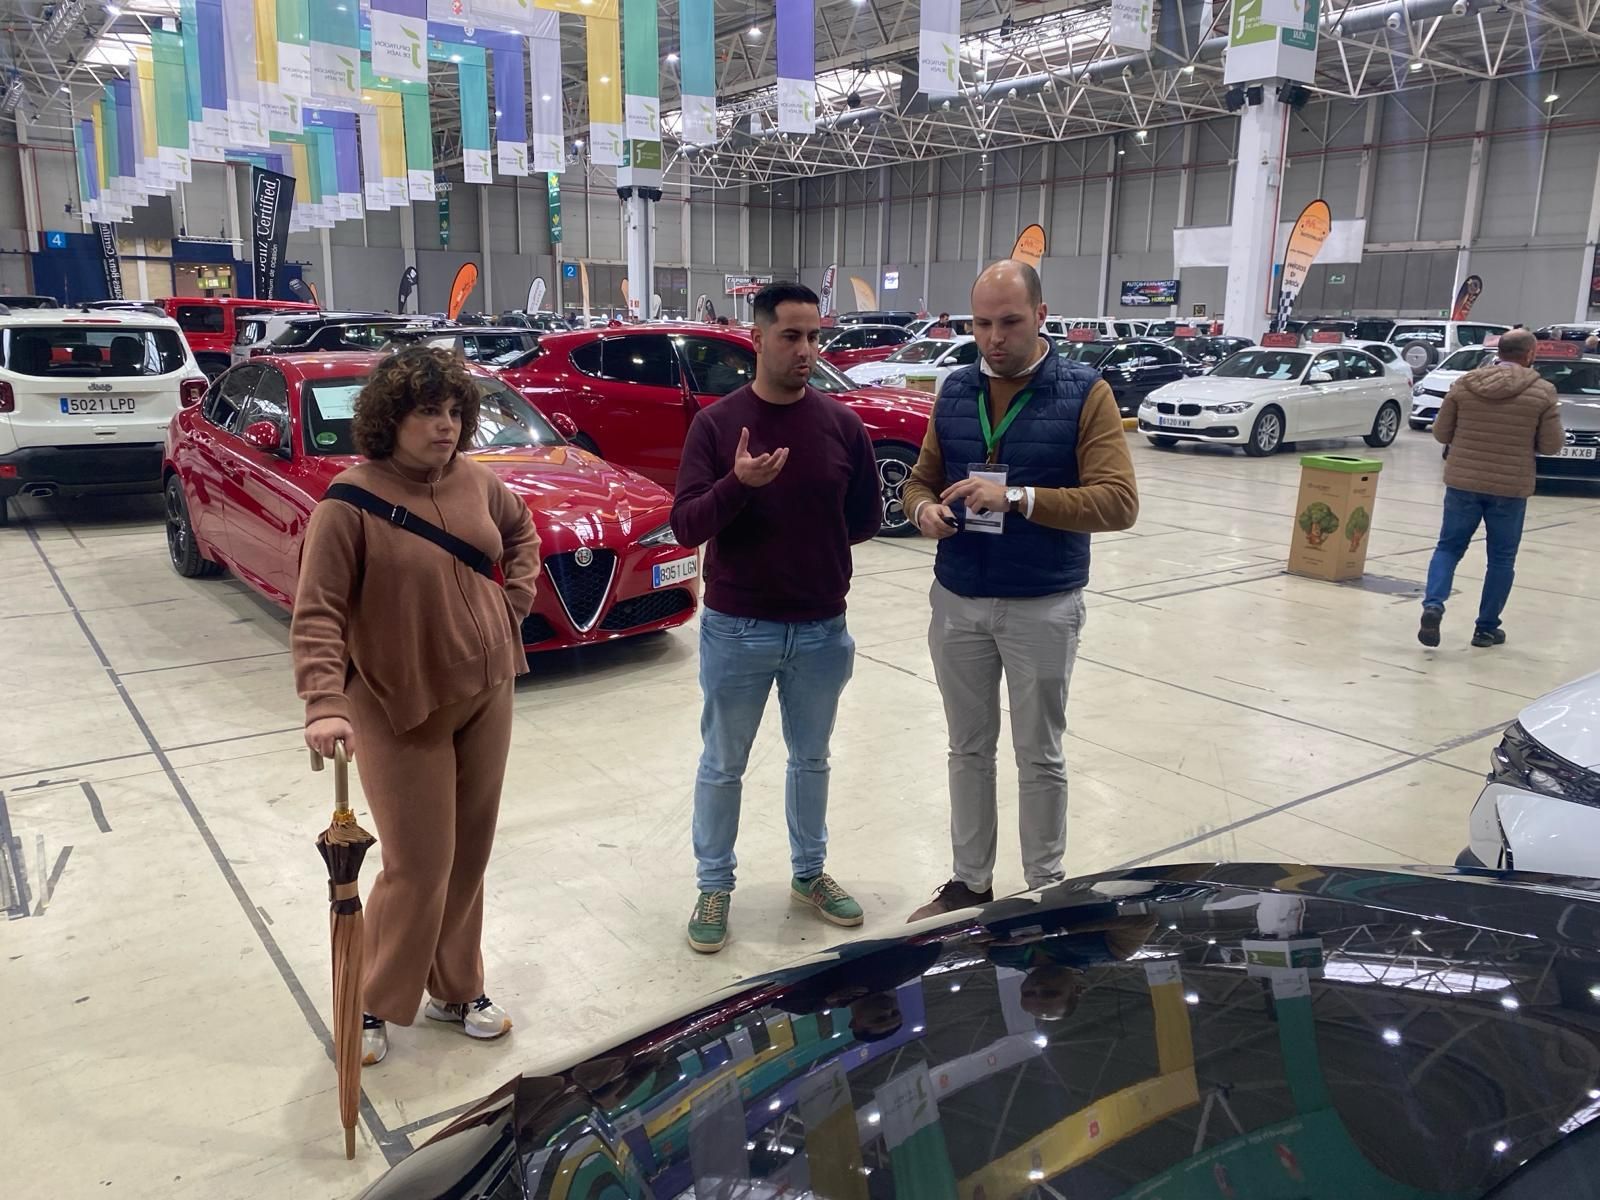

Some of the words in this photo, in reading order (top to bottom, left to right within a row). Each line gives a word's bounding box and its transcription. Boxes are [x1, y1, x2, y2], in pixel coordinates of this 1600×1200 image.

[257, 178, 277, 238] Certified
[51, 233, 62, 247] 4
[566, 266, 575, 277] 2
[70, 398, 105, 411] 5021
[109, 397, 136, 411] LPD
[1571, 447, 1593, 458] KXB
[660, 564, 681, 582] 8051
